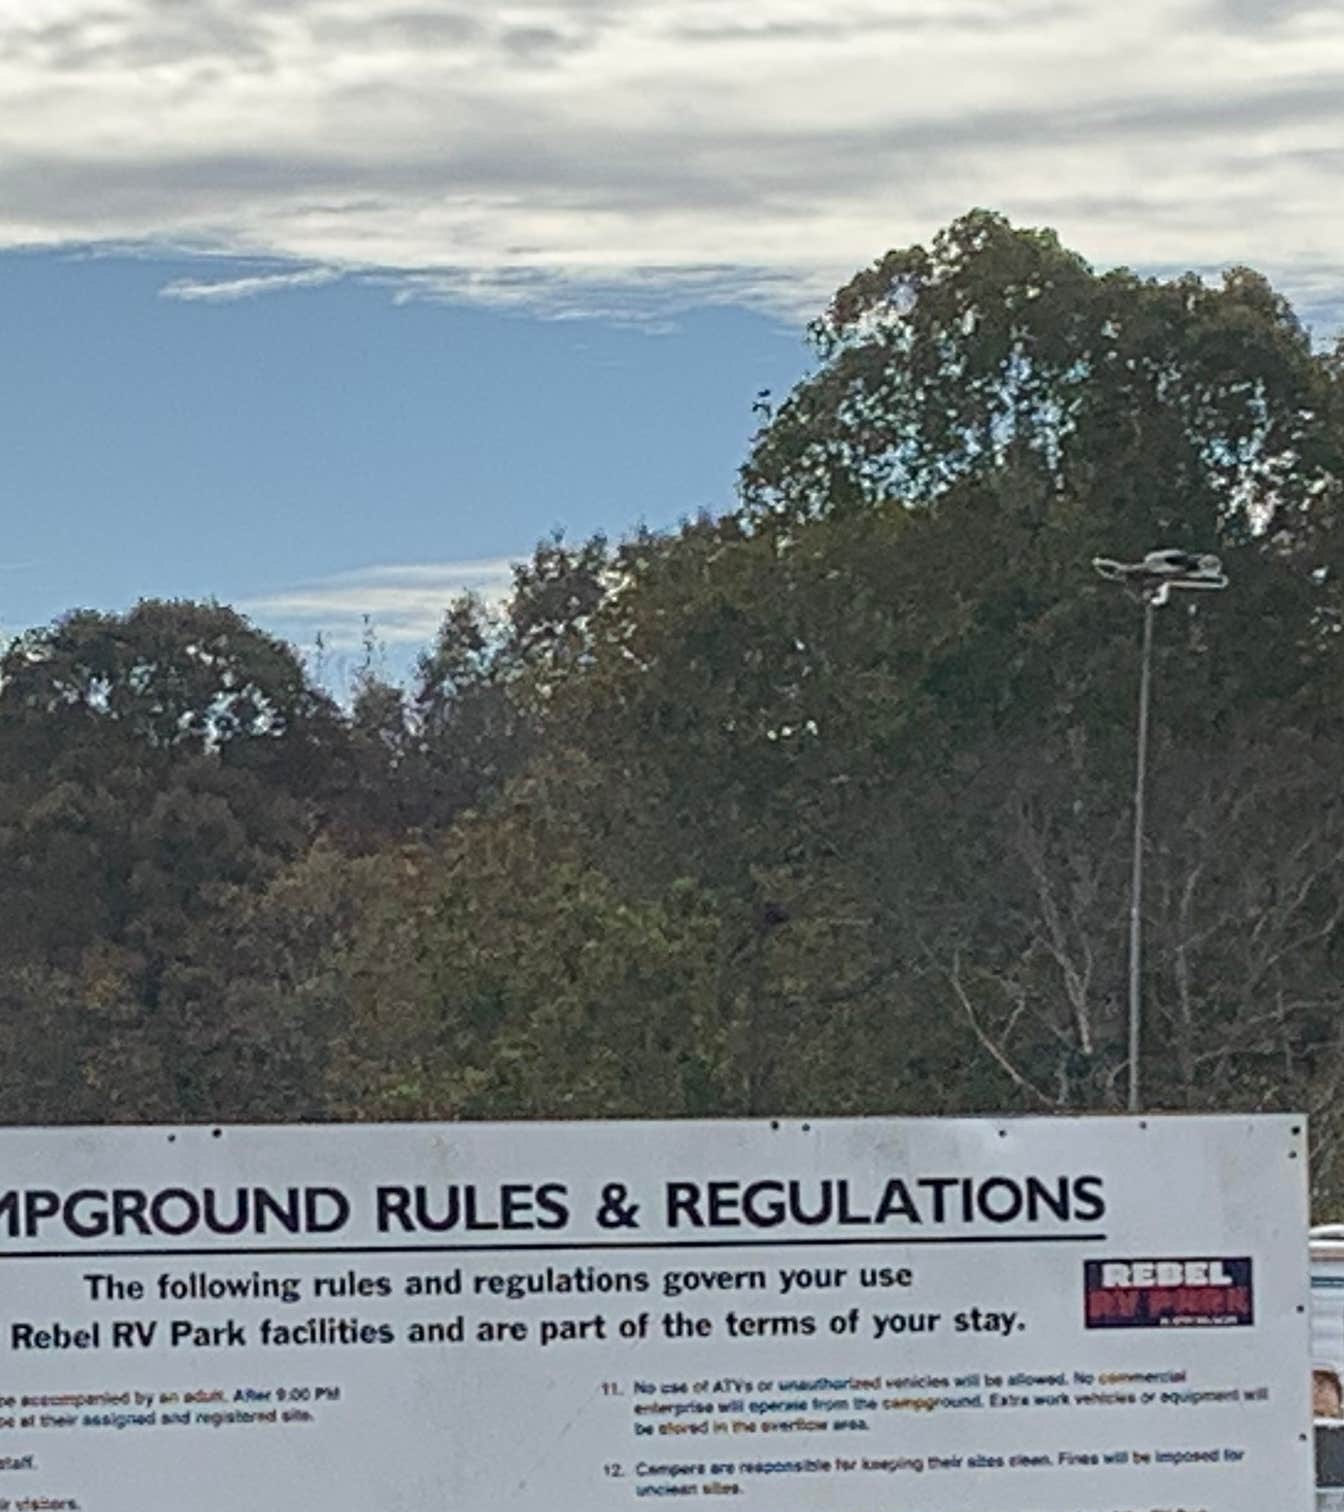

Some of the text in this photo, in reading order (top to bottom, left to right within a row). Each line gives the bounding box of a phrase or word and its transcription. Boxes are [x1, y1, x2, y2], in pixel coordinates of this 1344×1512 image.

[375, 1181, 570, 1233] RULES
[595, 1181, 640, 1230] &
[664, 1174, 1106, 1229] REGULATIONS
[84, 1265, 914, 1303] The following rules and regulations govern your use
[1101, 1261, 1233, 1287] REBEL
[10, 1320, 100, 1351] Rebel
[111, 1319, 158, 1349] RV
[169, 1317, 247, 1348] Park
[258, 1316, 395, 1346] facilities
[406, 1314, 465, 1344] and
[475, 1320, 528, 1342] are
[539, 1313, 607, 1347] part
[618, 1311, 650, 1339] of
[660, 1310, 713, 1339] the
[724, 1310, 817, 1338] terms
[828, 1306, 860, 1335] of
[871, 1312, 942, 1340] your
[952, 1306, 1026, 1337] stay.
